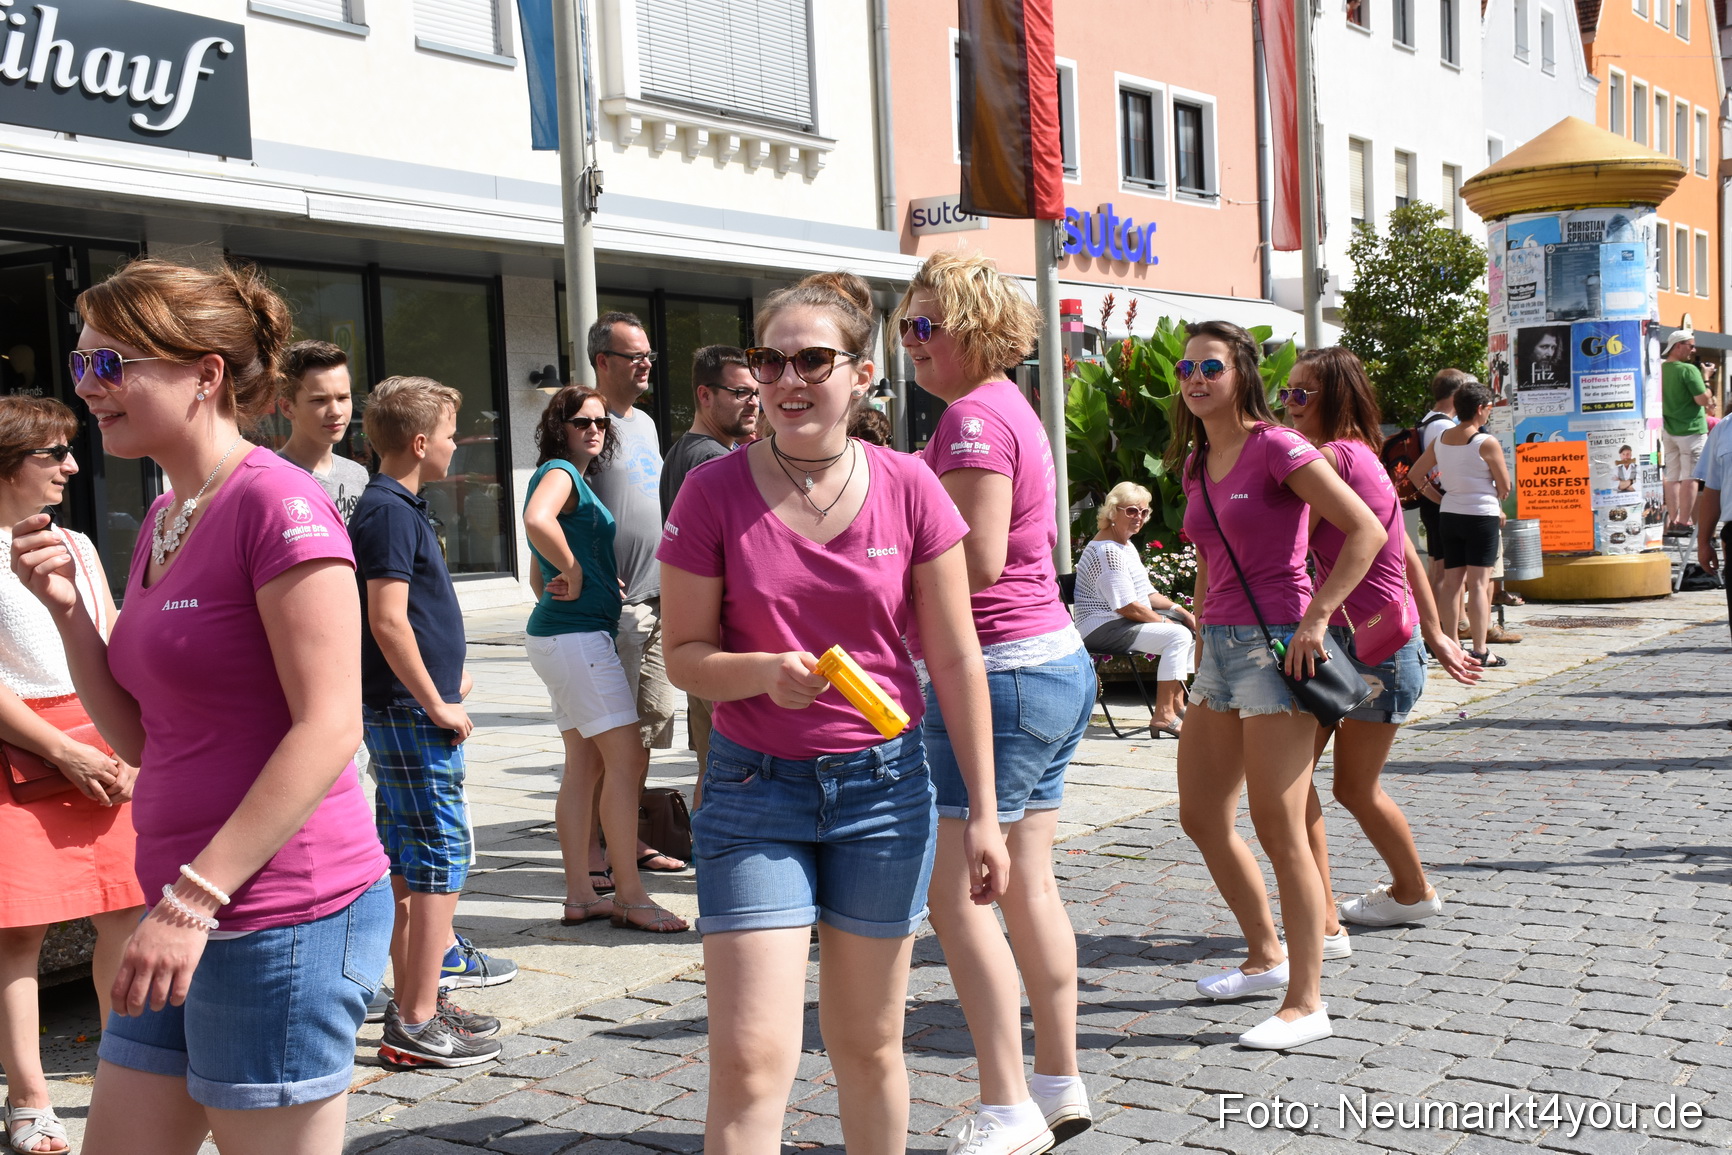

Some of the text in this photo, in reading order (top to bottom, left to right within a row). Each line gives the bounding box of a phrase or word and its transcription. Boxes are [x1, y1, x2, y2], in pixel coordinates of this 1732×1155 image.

[912, 201, 979, 227] suto.
[1567, 220, 1606, 233] CHRISTIAN
[1581, 334, 1622, 357] G6
[1522, 454, 1585, 463] Neumarkter
[1533, 465, 1571, 476] JURA-
[1518, 477, 1590, 488] VOLKSFEST
[282, 525, 311, 540] Winkler
[866, 544, 898, 558] Becci
[161, 598, 199, 611] Anna
